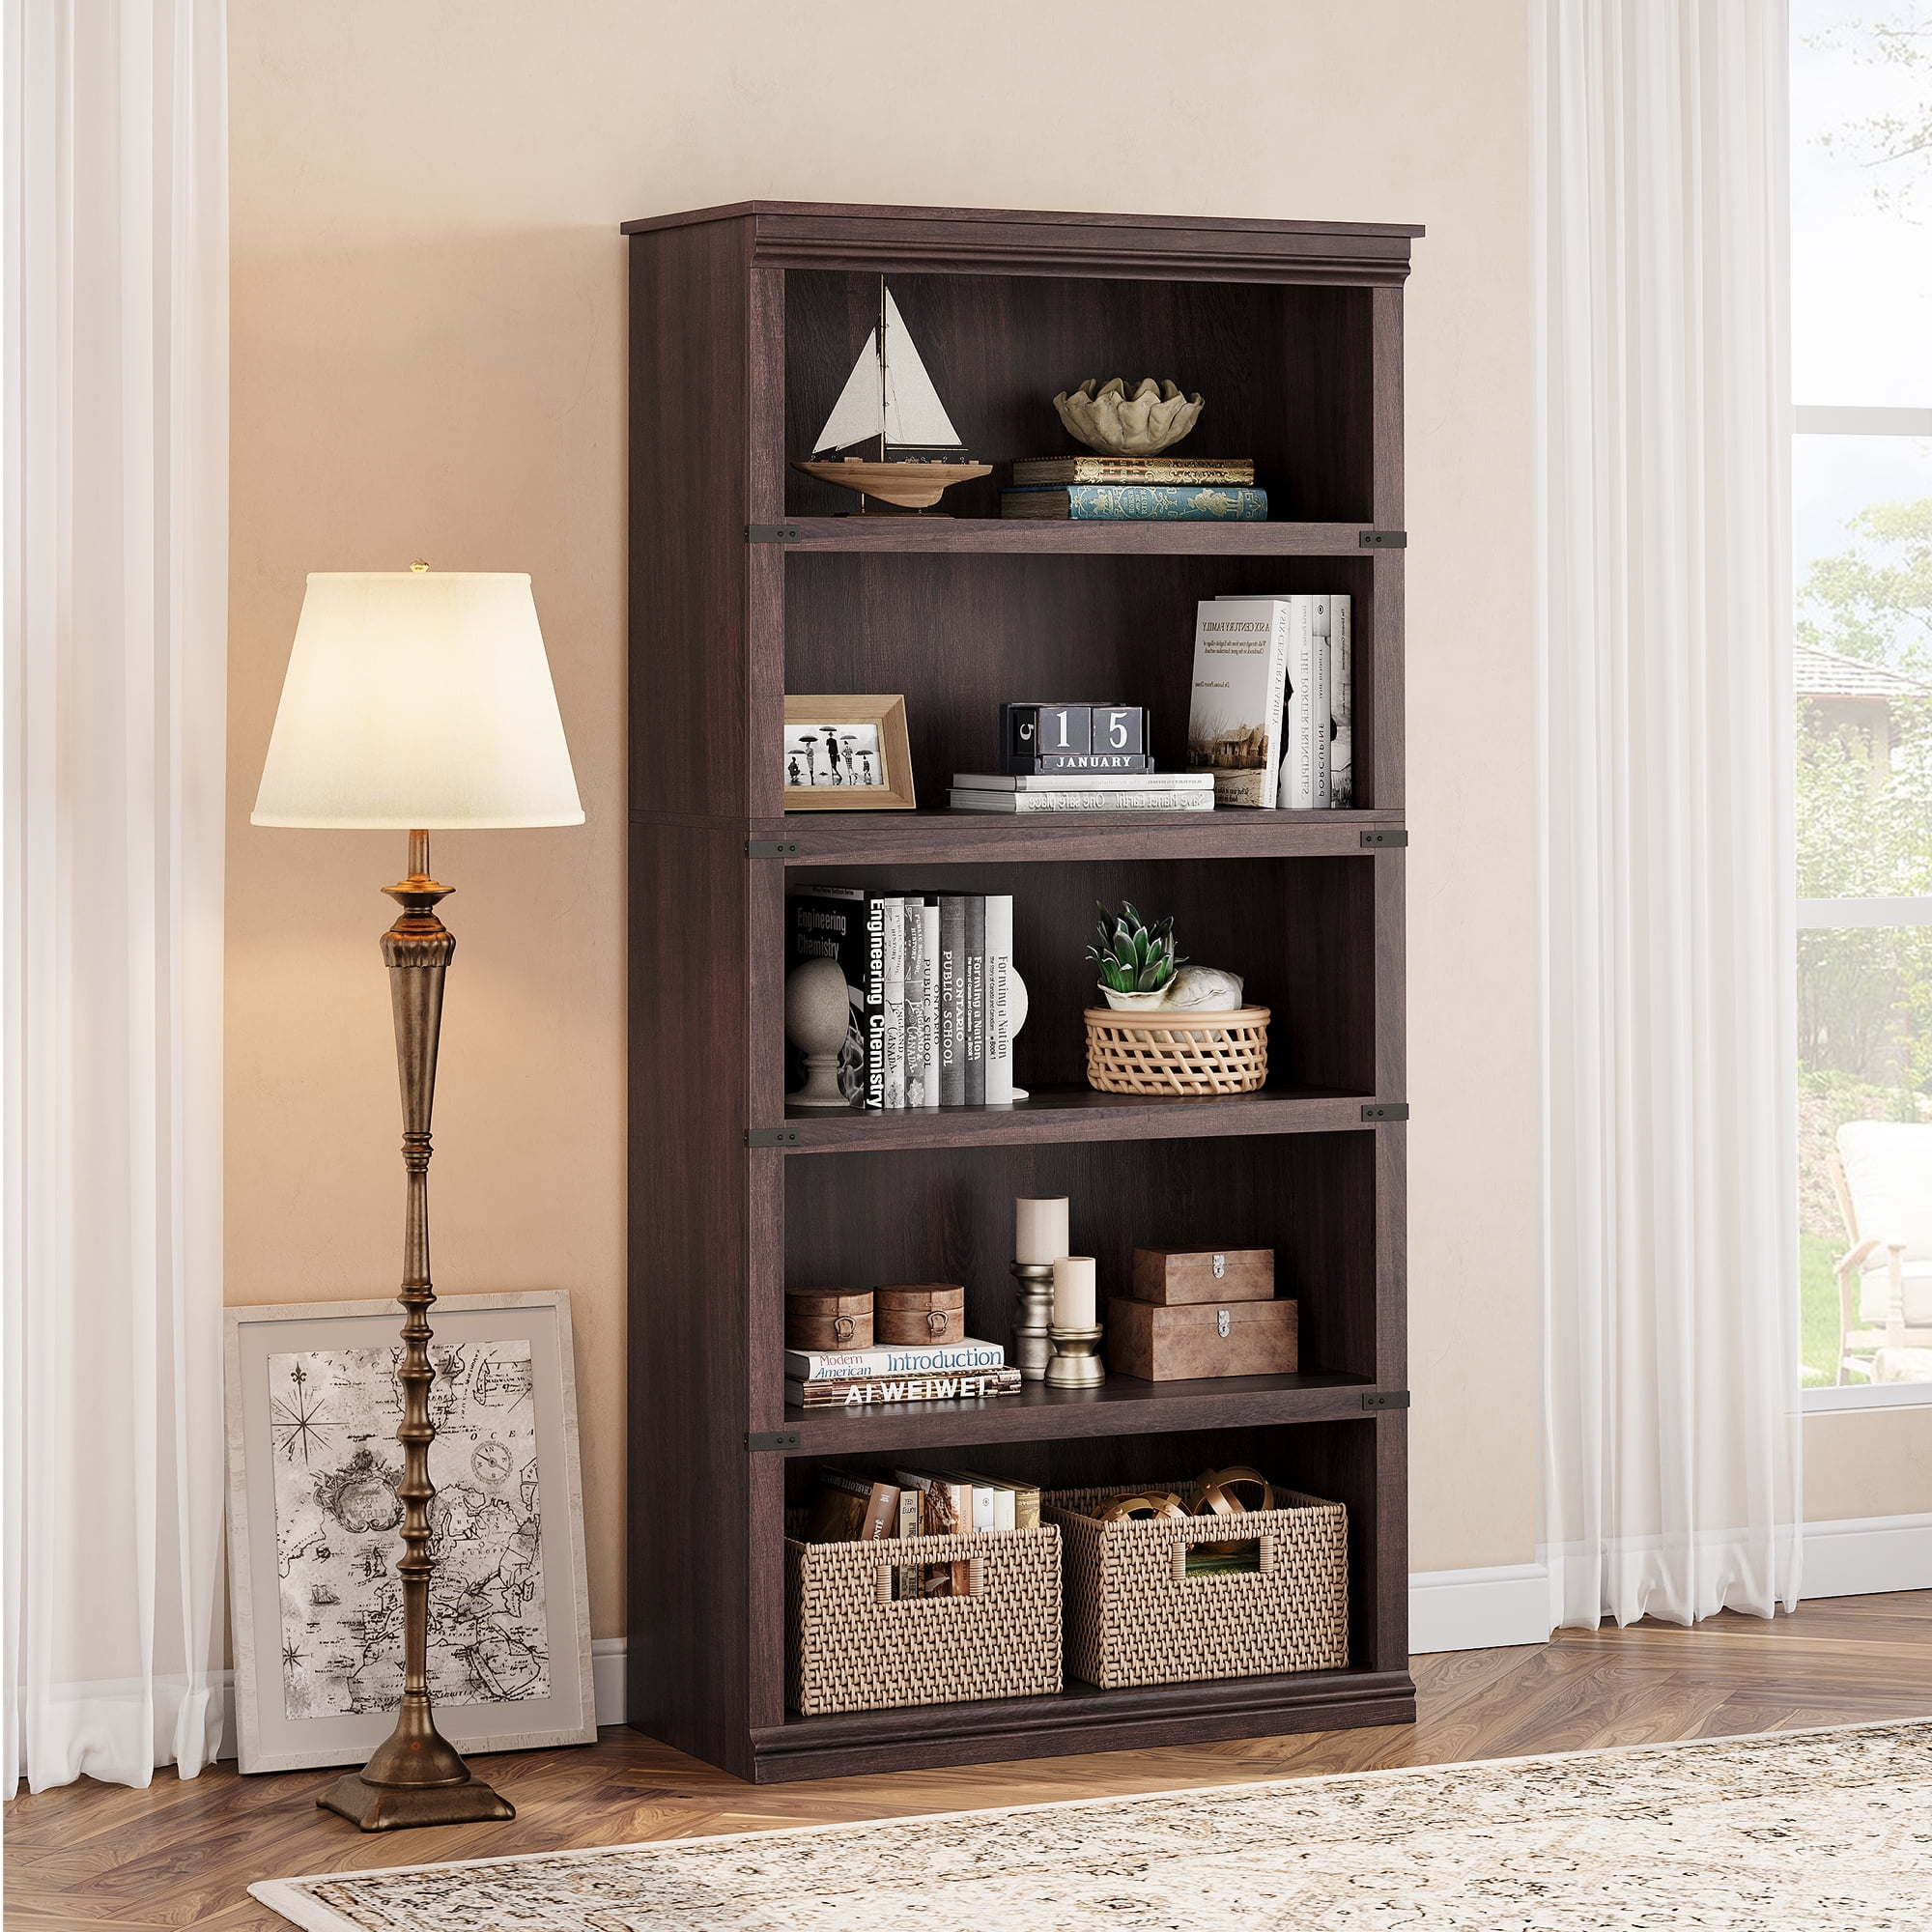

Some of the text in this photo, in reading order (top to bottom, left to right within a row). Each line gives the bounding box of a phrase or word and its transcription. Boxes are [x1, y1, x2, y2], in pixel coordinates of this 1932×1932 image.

[1056, 710, 1128, 749] 1 5
[1056, 756, 1133, 768] JANUARY
[797, 906, 847, 936] Engineering
[797, 933, 839, 962] Chemistry
[972, 956, 982, 1009] Forming
[997, 956, 1009, 1007] Forming
[867, 898, 885, 1108] Engineering Chemistry
[943, 951, 952, 1066] PUBLIC SCHOOL
[955, 978, 964, 1041] ONTARIO
[885, 999, 904, 1053] ENGLAND
[905, 999, 923, 1053] ENGLAND
[974, 1020, 982, 1061] Nation
[999, 1020, 1009, 1059] Nation
[814, 1366, 871, 1379] American
[820, 1354, 864, 1367] Modern
[887, 1348, 1003, 1373] Introduction
[844, 1377, 985, 1406] AI WEIWEI
[840, 1477, 873, 1496] CHARLOTTE
[348, 1509, 387, 1520] WORLD
[872, 1519, 885, 1542] ONTE
